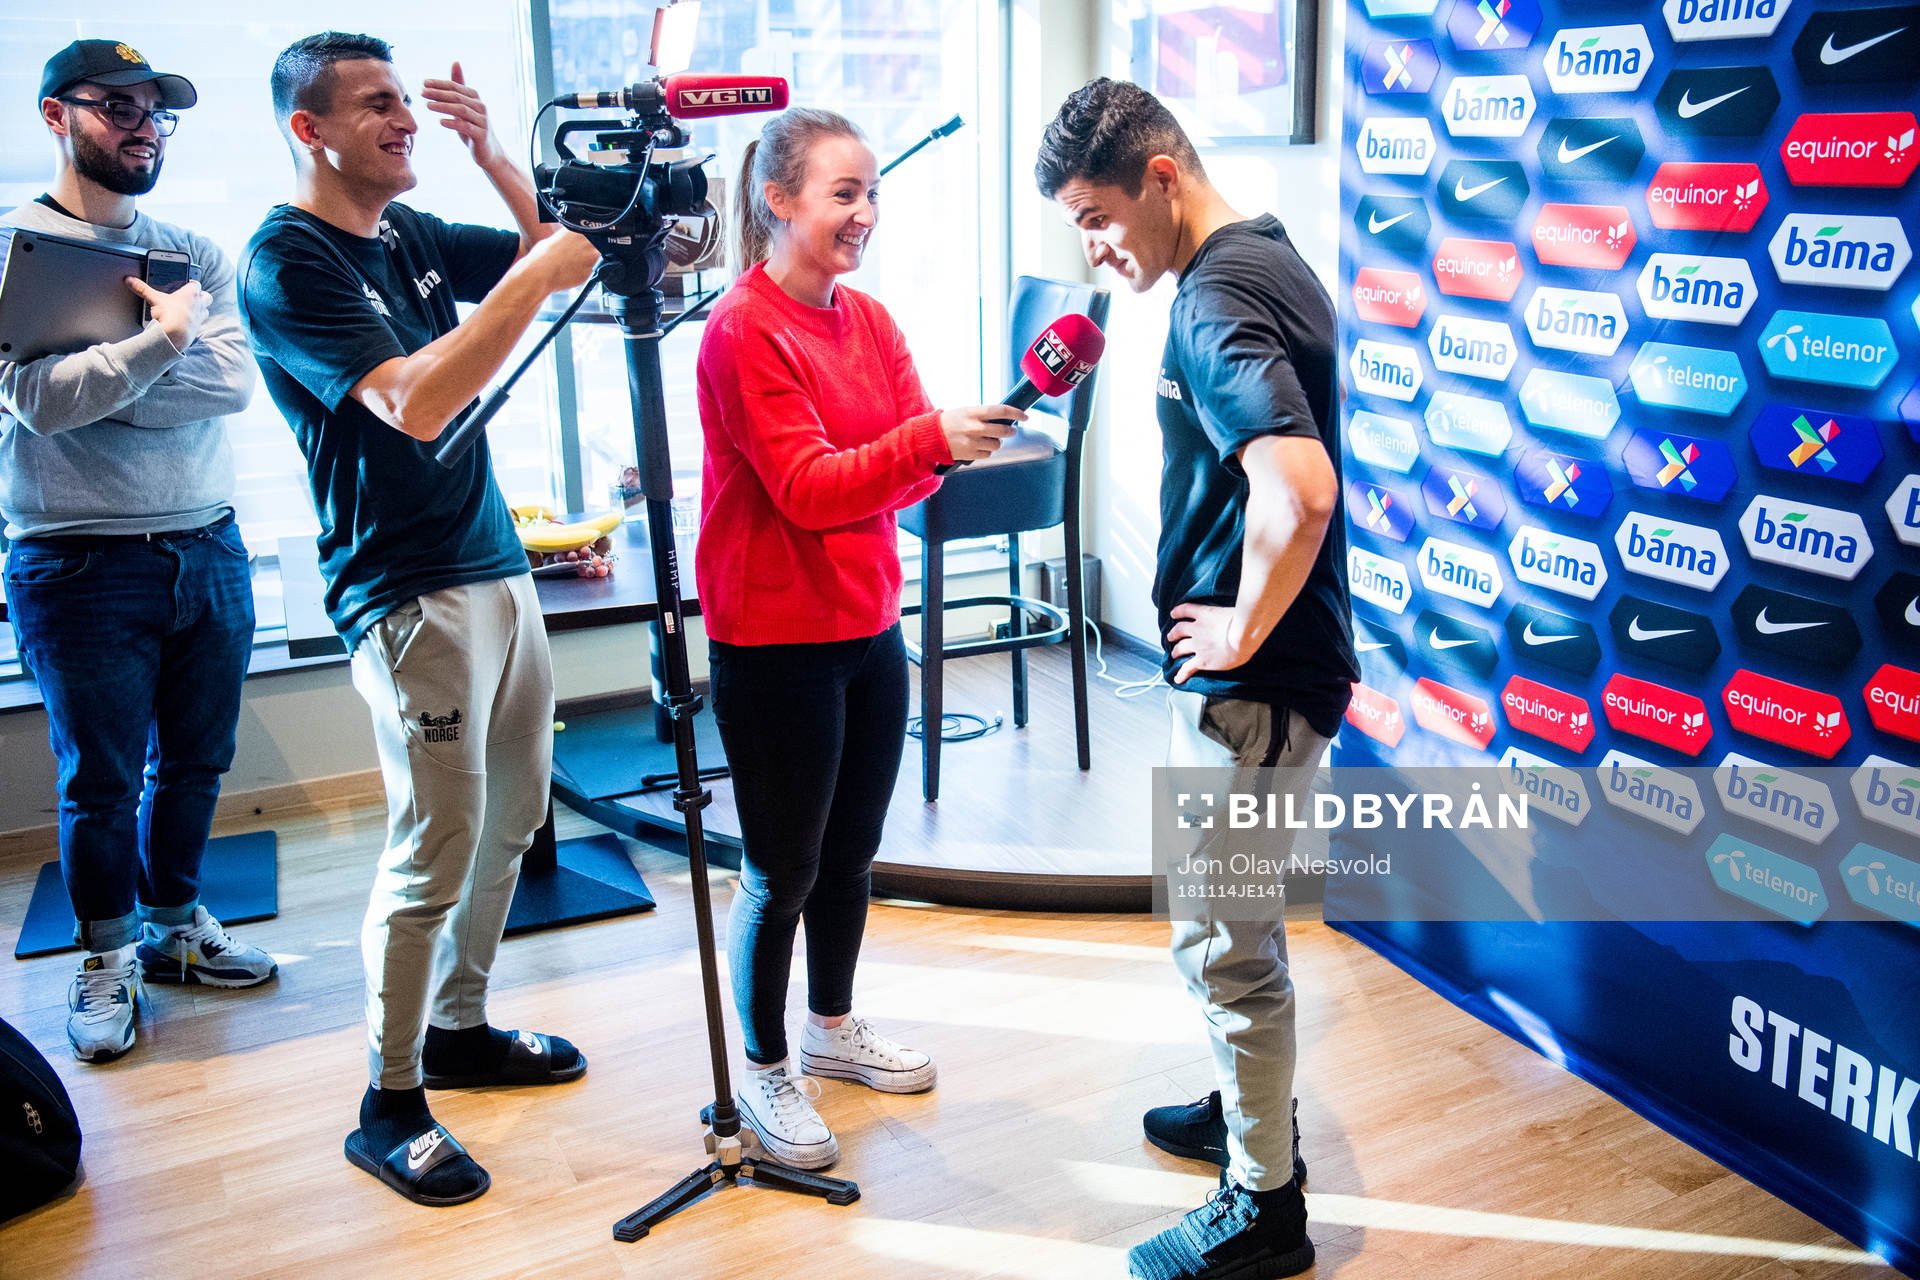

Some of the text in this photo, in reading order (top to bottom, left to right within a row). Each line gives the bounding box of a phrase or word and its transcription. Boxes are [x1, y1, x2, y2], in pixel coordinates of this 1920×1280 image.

[1557, 41, 1641, 77] bama
[683, 89, 767, 105] VG TV
[1453, 88, 1525, 121] bama
[1366, 128, 1426, 160] bama
[1787, 136, 1878, 164] equinor
[1651, 184, 1728, 208] equinor
[1536, 223, 1601, 244] equinor
[1785, 226, 1895, 272] bama
[1437, 257, 1493, 277] equinor
[1355, 285, 1401, 305] equinor
[1651, 265, 1744, 309] bama
[1537, 298, 1617, 340] bama
[1038, 341, 1062, 368] TV
[1047, 331, 1071, 360] VG
[1439, 326, 1507, 365] bama
[1802, 336, 1887, 363] telenor
[1359, 350, 1414, 388] bama
[1667, 365, 1738, 393] telenor
[1551, 391, 1613, 417] telenor
[1370, 430, 1412, 456] telenor
[1628, 523, 1716, 575] bama
[1754, 507, 1858, 563] bama
[1427, 547, 1493, 595] bama
[1520, 536, 1597, 586] bama
[1352, 556, 1404, 601] bama
[1350, 696, 1382, 722] quinor
[1413, 693, 1467, 724] equinor
[1505, 691, 1566, 725] equinor
[1606, 691, 1677, 725] equinor
[1728, 689, 1807, 725] equinor
[424, 727, 460, 743] NORGE
[1511, 757, 1580, 813] bama
[1610, 760, 1693, 821] bama
[1727, 764, 1825, 829] bama
[1867, 768, 1920, 820] ba
[1744, 862, 1818, 907] telenor
[1729, 995, 1920, 1161] STERK
[408, 1129, 441, 1157] NIKE
